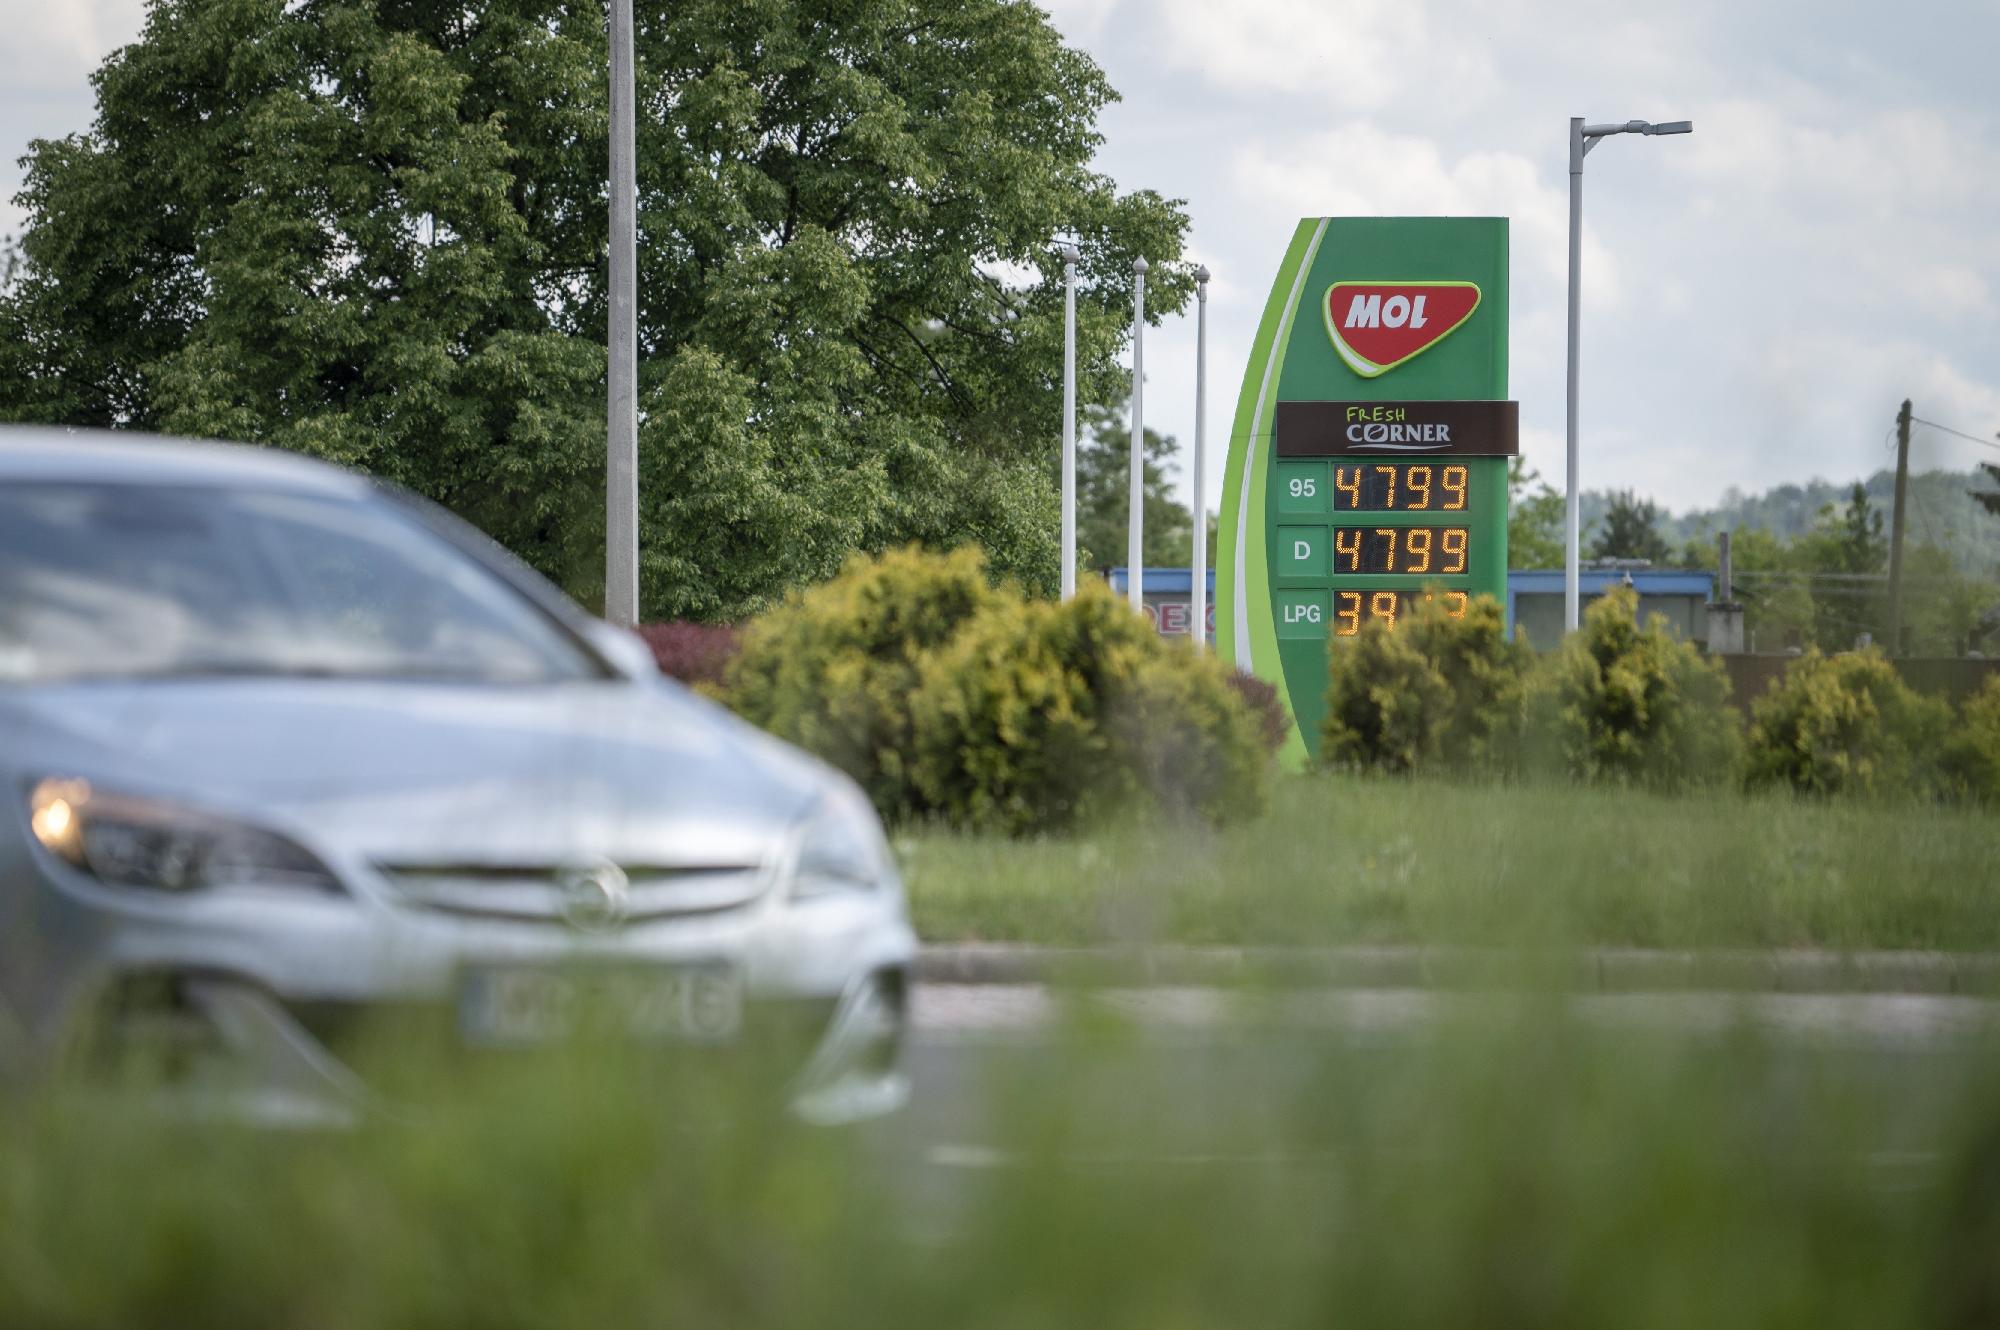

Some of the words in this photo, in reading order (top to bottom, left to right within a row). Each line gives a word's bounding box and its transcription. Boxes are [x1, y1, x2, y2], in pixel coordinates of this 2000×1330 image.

[1344, 295, 1428, 329] MOL
[1346, 406, 1405, 422] FRESH
[1346, 423, 1451, 443] CORNER
[1289, 478, 1316, 497] 95
[1336, 466, 1468, 509] 4799
[1294, 541, 1311, 560] D
[1336, 529, 1468, 573] 4799
[1284, 605, 1321, 624] LPG
